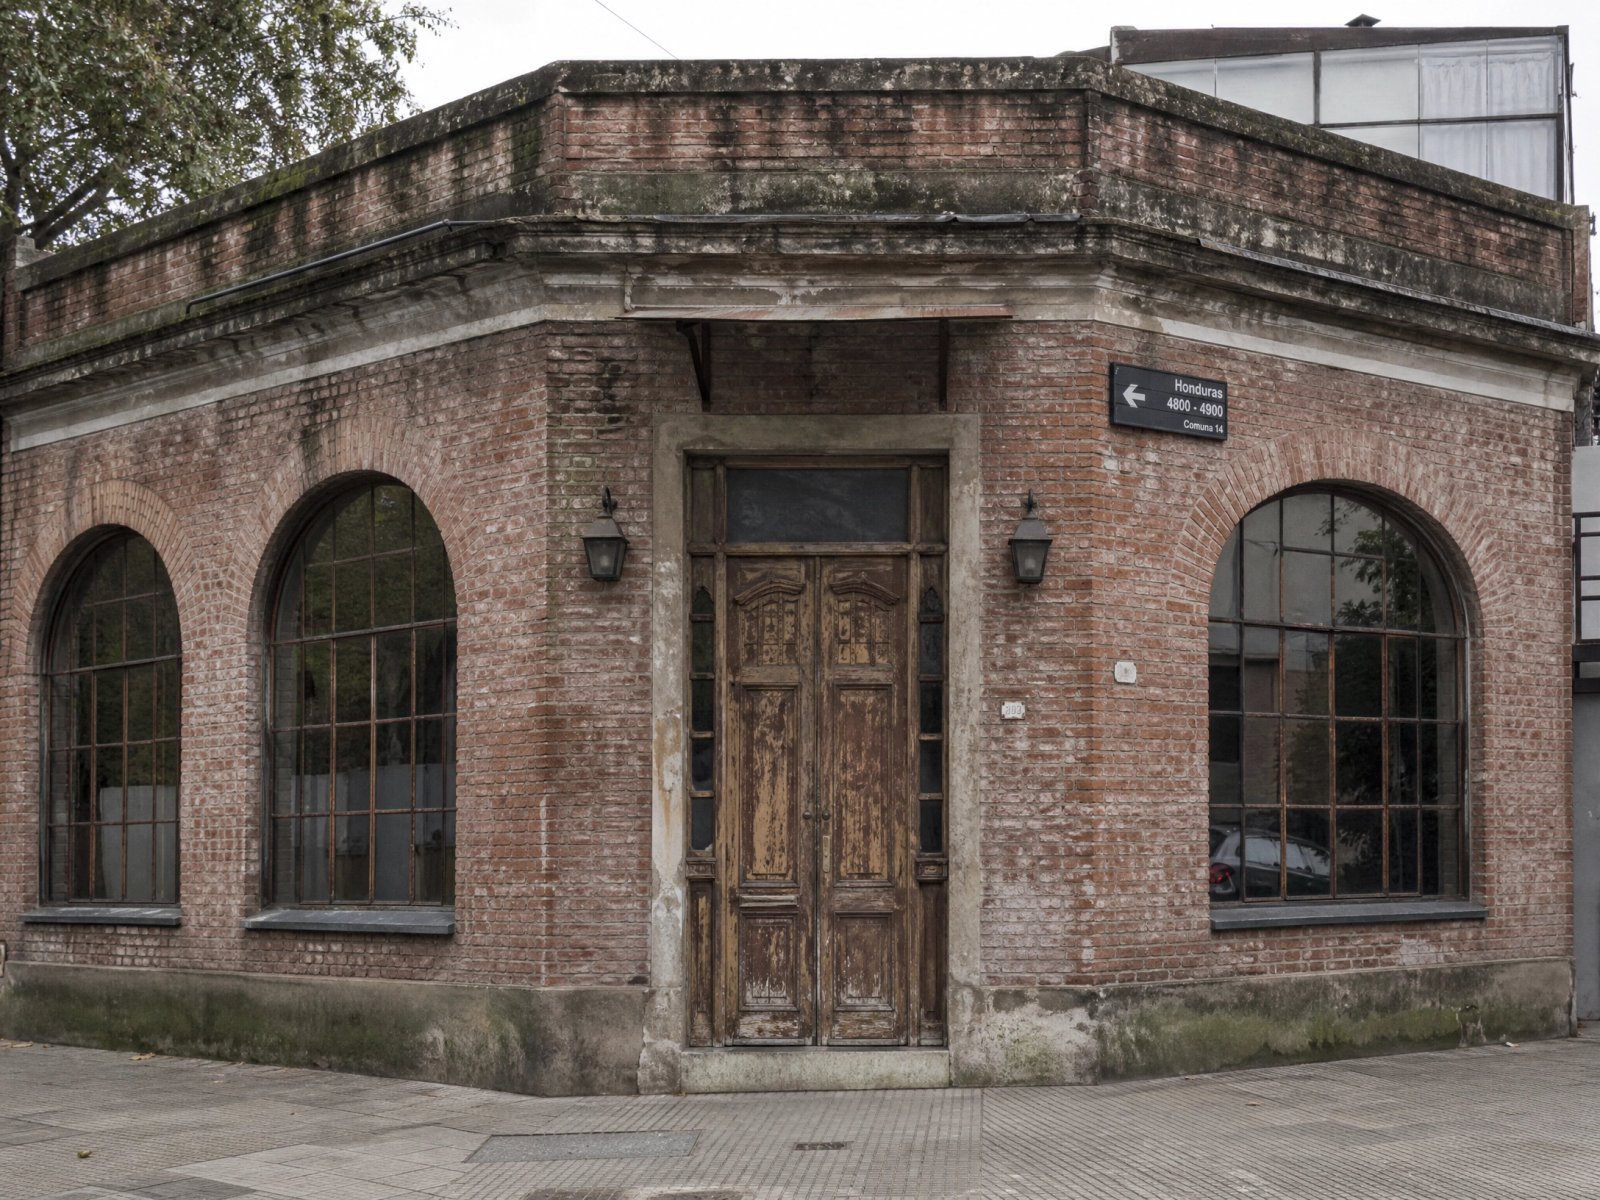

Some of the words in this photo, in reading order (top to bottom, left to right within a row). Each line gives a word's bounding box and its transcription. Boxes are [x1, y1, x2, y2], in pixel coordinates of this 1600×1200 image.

[1175, 379, 1223, 399] Honduras
[1167, 397, 1191, 412] 4800
[1200, 402, 1223, 417] 4900
[1183, 419, 1213, 432] Comuna
[1215, 424, 1224, 434] 14
